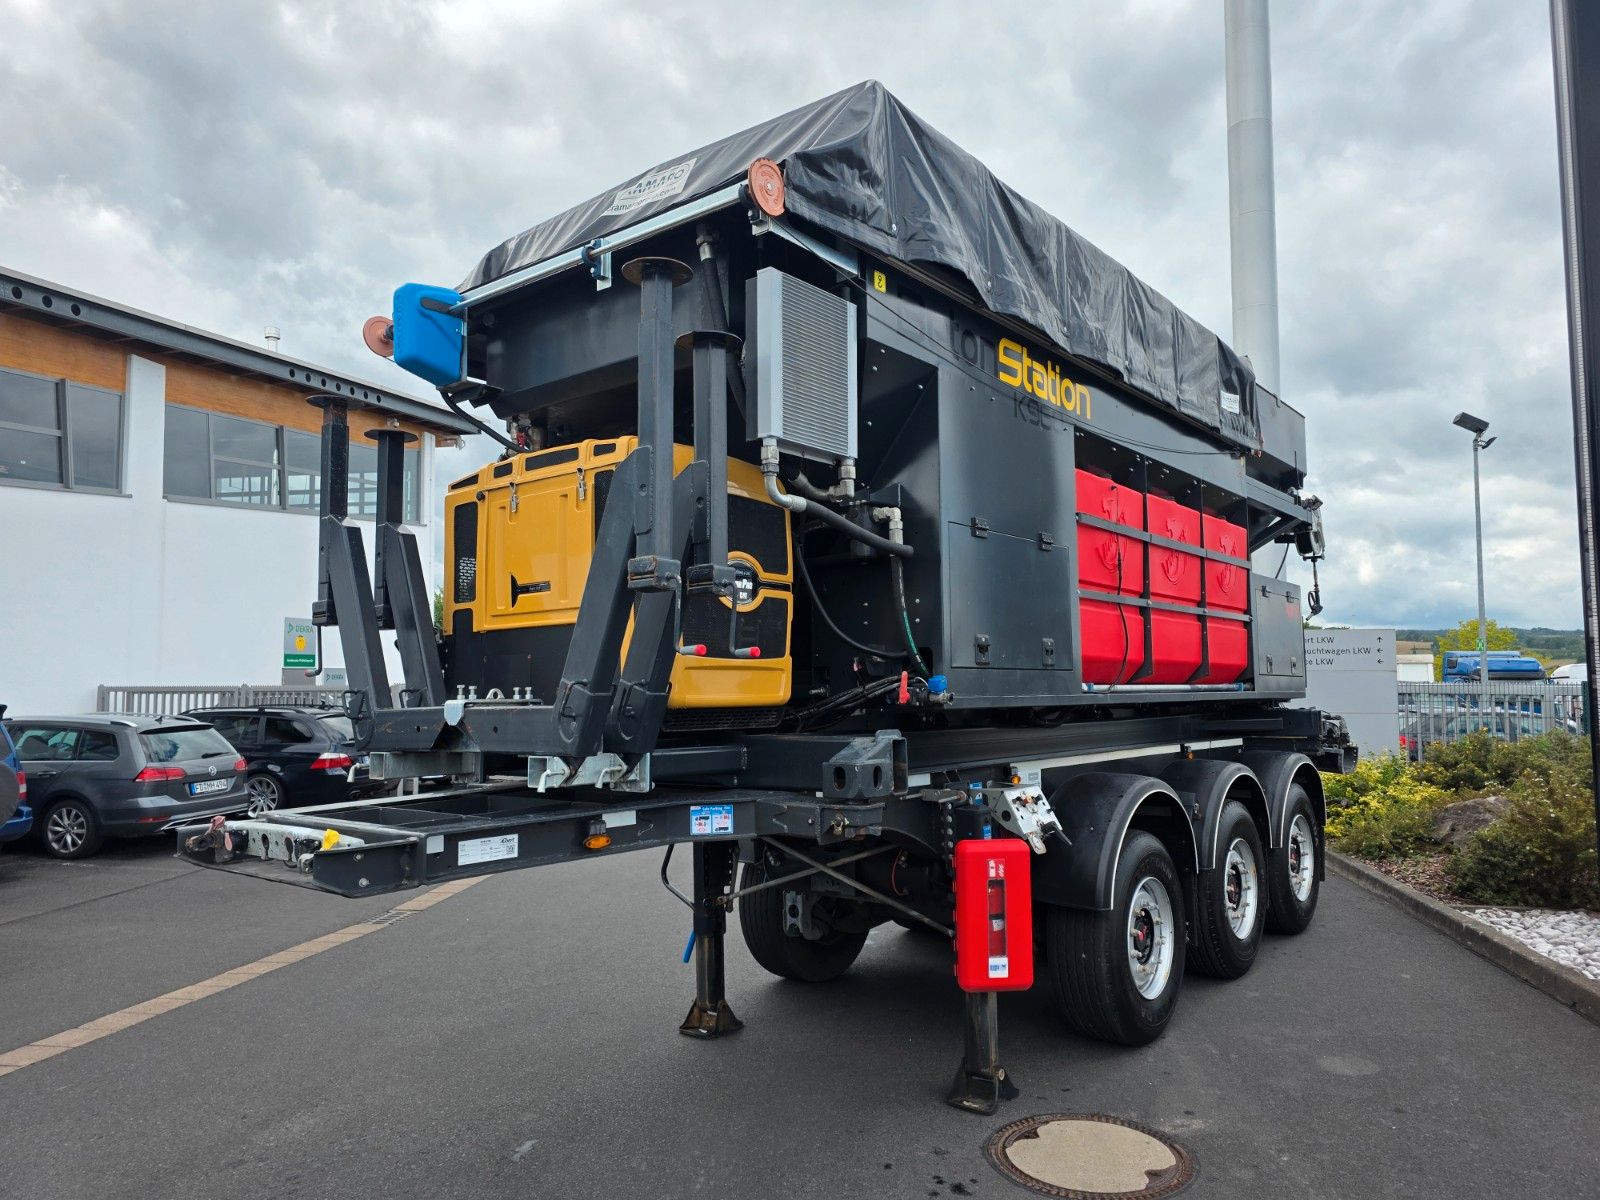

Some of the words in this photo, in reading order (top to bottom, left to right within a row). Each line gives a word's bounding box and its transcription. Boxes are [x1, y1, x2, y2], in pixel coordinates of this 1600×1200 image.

[1316, 636, 1335, 644] LKW
[1352, 647, 1372, 655] LKW
[1315, 658, 1334, 666] LKW
